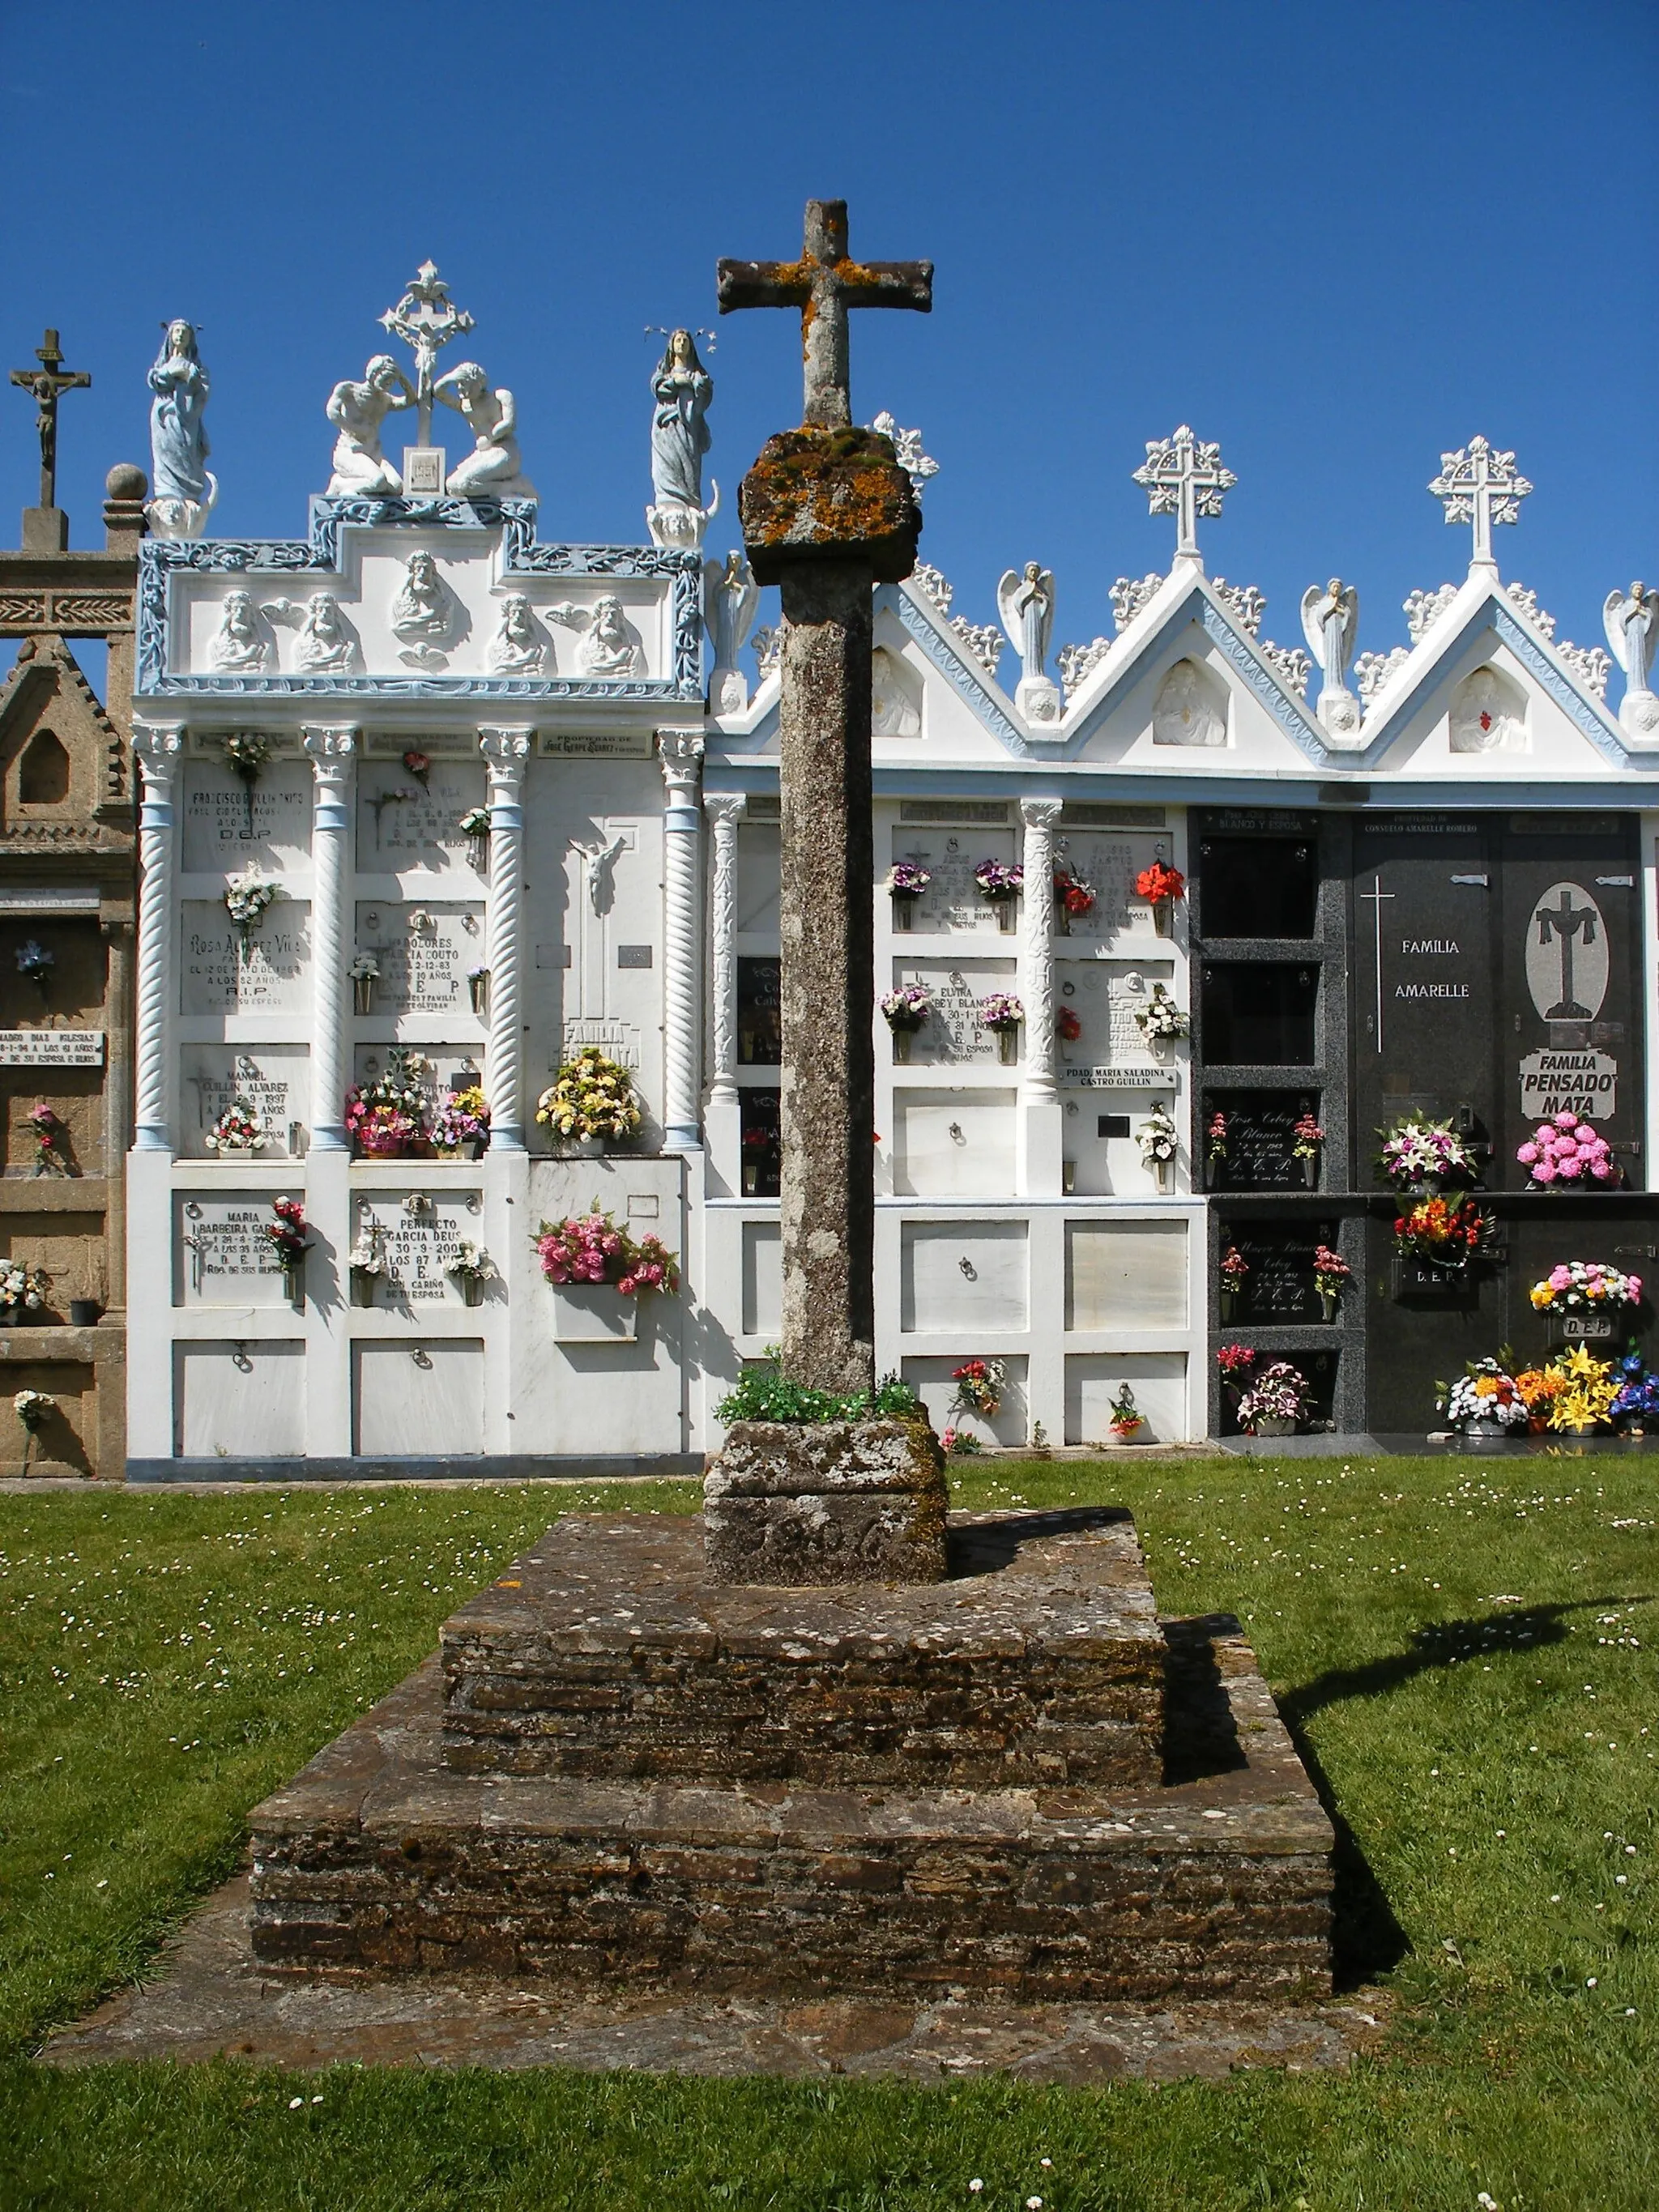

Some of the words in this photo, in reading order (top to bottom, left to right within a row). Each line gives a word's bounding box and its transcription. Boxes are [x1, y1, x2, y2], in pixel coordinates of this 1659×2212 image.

[194, 792, 241, 804] FRACISCO
[1405, 825, 1444, 833] AMARELLE
[1446, 825, 1478, 833] ROMERO
[224, 934, 272, 955] ALAREZ
[404, 938, 452, 948] DOLORES
[1402, 940, 1460, 953] FAMILIA
[222, 956, 271, 964] FALECIO
[426, 950, 458, 960] COUTO
[190, 965, 201, 974] EL
[232, 965, 258, 974] MAYO
[261, 966, 274, 974] DE
[416, 961, 450, 970] 2-12-83
[207, 976, 213, 984] A
[217, 976, 236, 984] LOS
[416, 972, 425, 980] 10
[429, 970, 452, 980] AÑOS
[940, 988, 973, 997] ELVIRA
[1395, 984, 1469, 997] AMARELLE
[932, 999, 953, 1008] BEY
[958, 999, 987, 1008] BLAN
[955, 1021, 964, 1029] 81
[31, 1034, 50, 1042] DIAZ
[59, 1034, 95, 1042] IGLESIAS
[564, 1025, 625, 1044] FAMILIA
[32, 1044, 38, 1052] A
[44, 1044, 59, 1052] LOS
[74, 1043, 94, 1052] AÑOS
[10, 1055, 20, 1063] DE
[23, 1055, 34, 1063] SU
[38, 1055, 65, 1063] ESPOSA
[68, 1055, 74, 1063] E
[75, 1055, 96, 1063] HIJOS
[1539, 1055, 1597, 1070] FAMILIA
[228, 1071, 267, 1081] MANUEL
[1095, 1069, 1121, 1077] MARIA
[1124, 1069, 1165, 1077] SALADINA
[1081, 1077, 1115, 1086] CASTRO
[1116, 1077, 1151, 1086] GUILLIN
[1525, 1073, 1612, 1093] PENSADO
[248, 1082, 289, 1093] ALVAREZ
[261, 1106, 286, 1115] AÑOS
[1542, 1096, 1594, 1115] MATA
[261, 1131, 285, 1139] SPOSA
[228, 1213, 260, 1222] MARIA
[199, 1223, 248, 1234] BARBEIRA
[252, 1224, 271, 1234] GAR
[400, 1219, 457, 1230] PERFECTO
[388, 1231, 428, 1242] GARCIA
[213, 1245, 219, 1254] A
[389, 1256, 410, 1265] LOS
[416, 1255, 429, 1265] 87
[1417, 1271, 1427, 1281] D.
[412, 1278, 444, 1289] CARIÑO
[1567, 1320, 1579, 1333] D.
